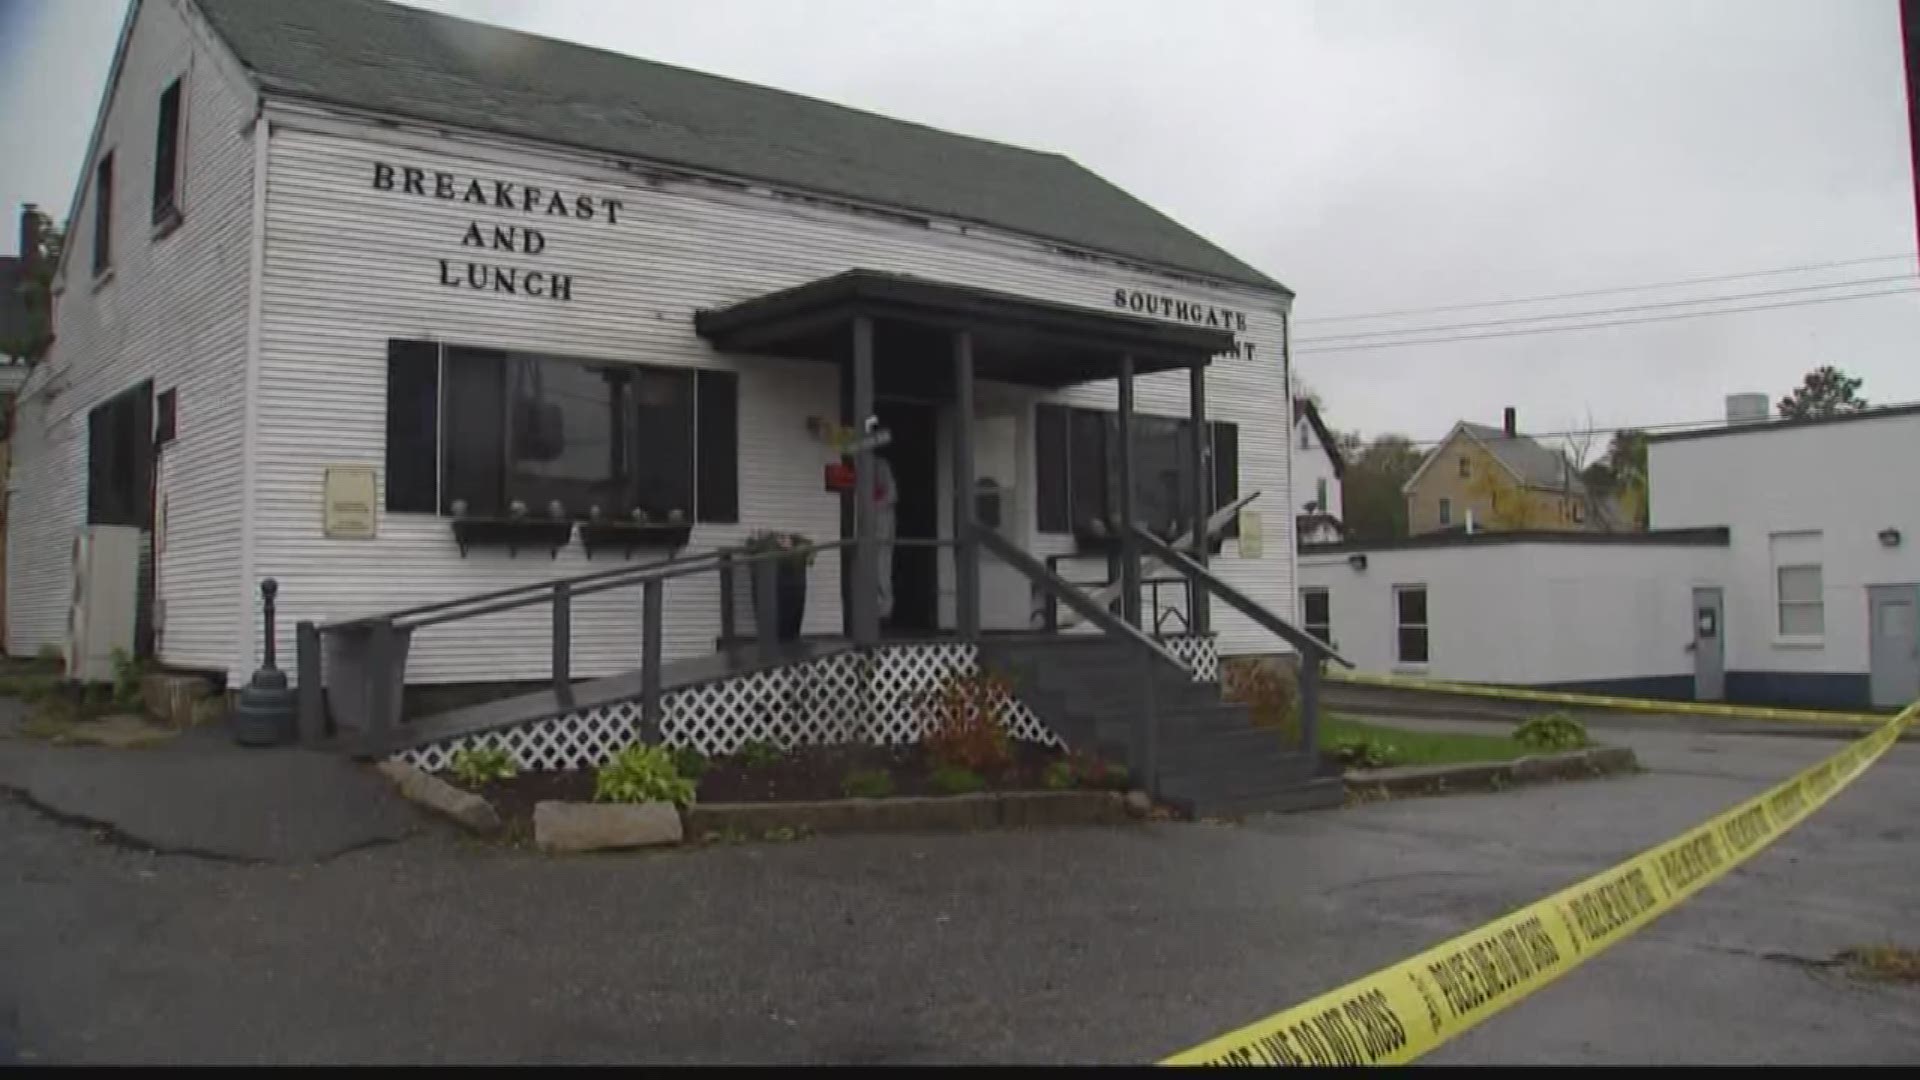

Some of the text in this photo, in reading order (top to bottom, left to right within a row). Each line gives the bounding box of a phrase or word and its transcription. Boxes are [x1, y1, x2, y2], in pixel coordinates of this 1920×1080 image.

[373, 161, 624, 224] BREAKFAST
[461, 220, 545, 254] AND
[439, 258, 573, 300] LUNCH
[1115, 288, 1248, 332] SOUTHGATE
[1343, 987, 1407, 1063] CROSS
